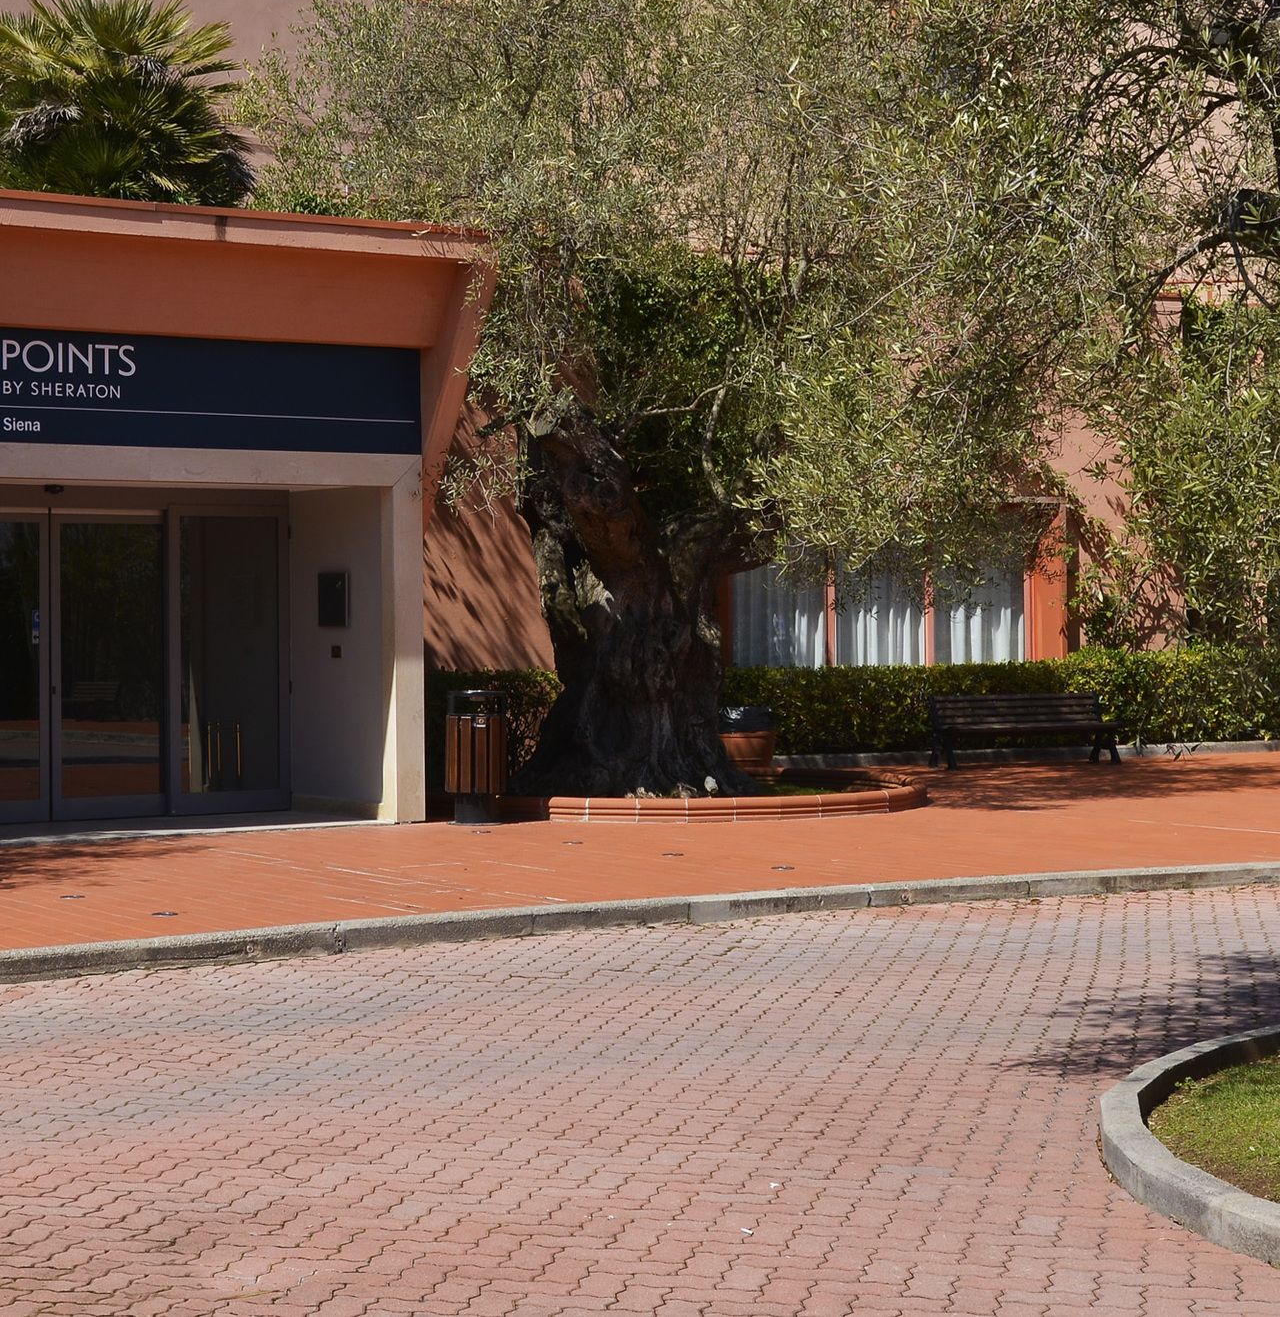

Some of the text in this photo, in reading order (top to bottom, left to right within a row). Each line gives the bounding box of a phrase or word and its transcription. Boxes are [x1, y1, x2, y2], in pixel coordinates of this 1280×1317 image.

[2, 339, 136, 376] POINTS
[2, 380, 121, 399] BY SHERATON
[3, 417, 41, 432] Siena
